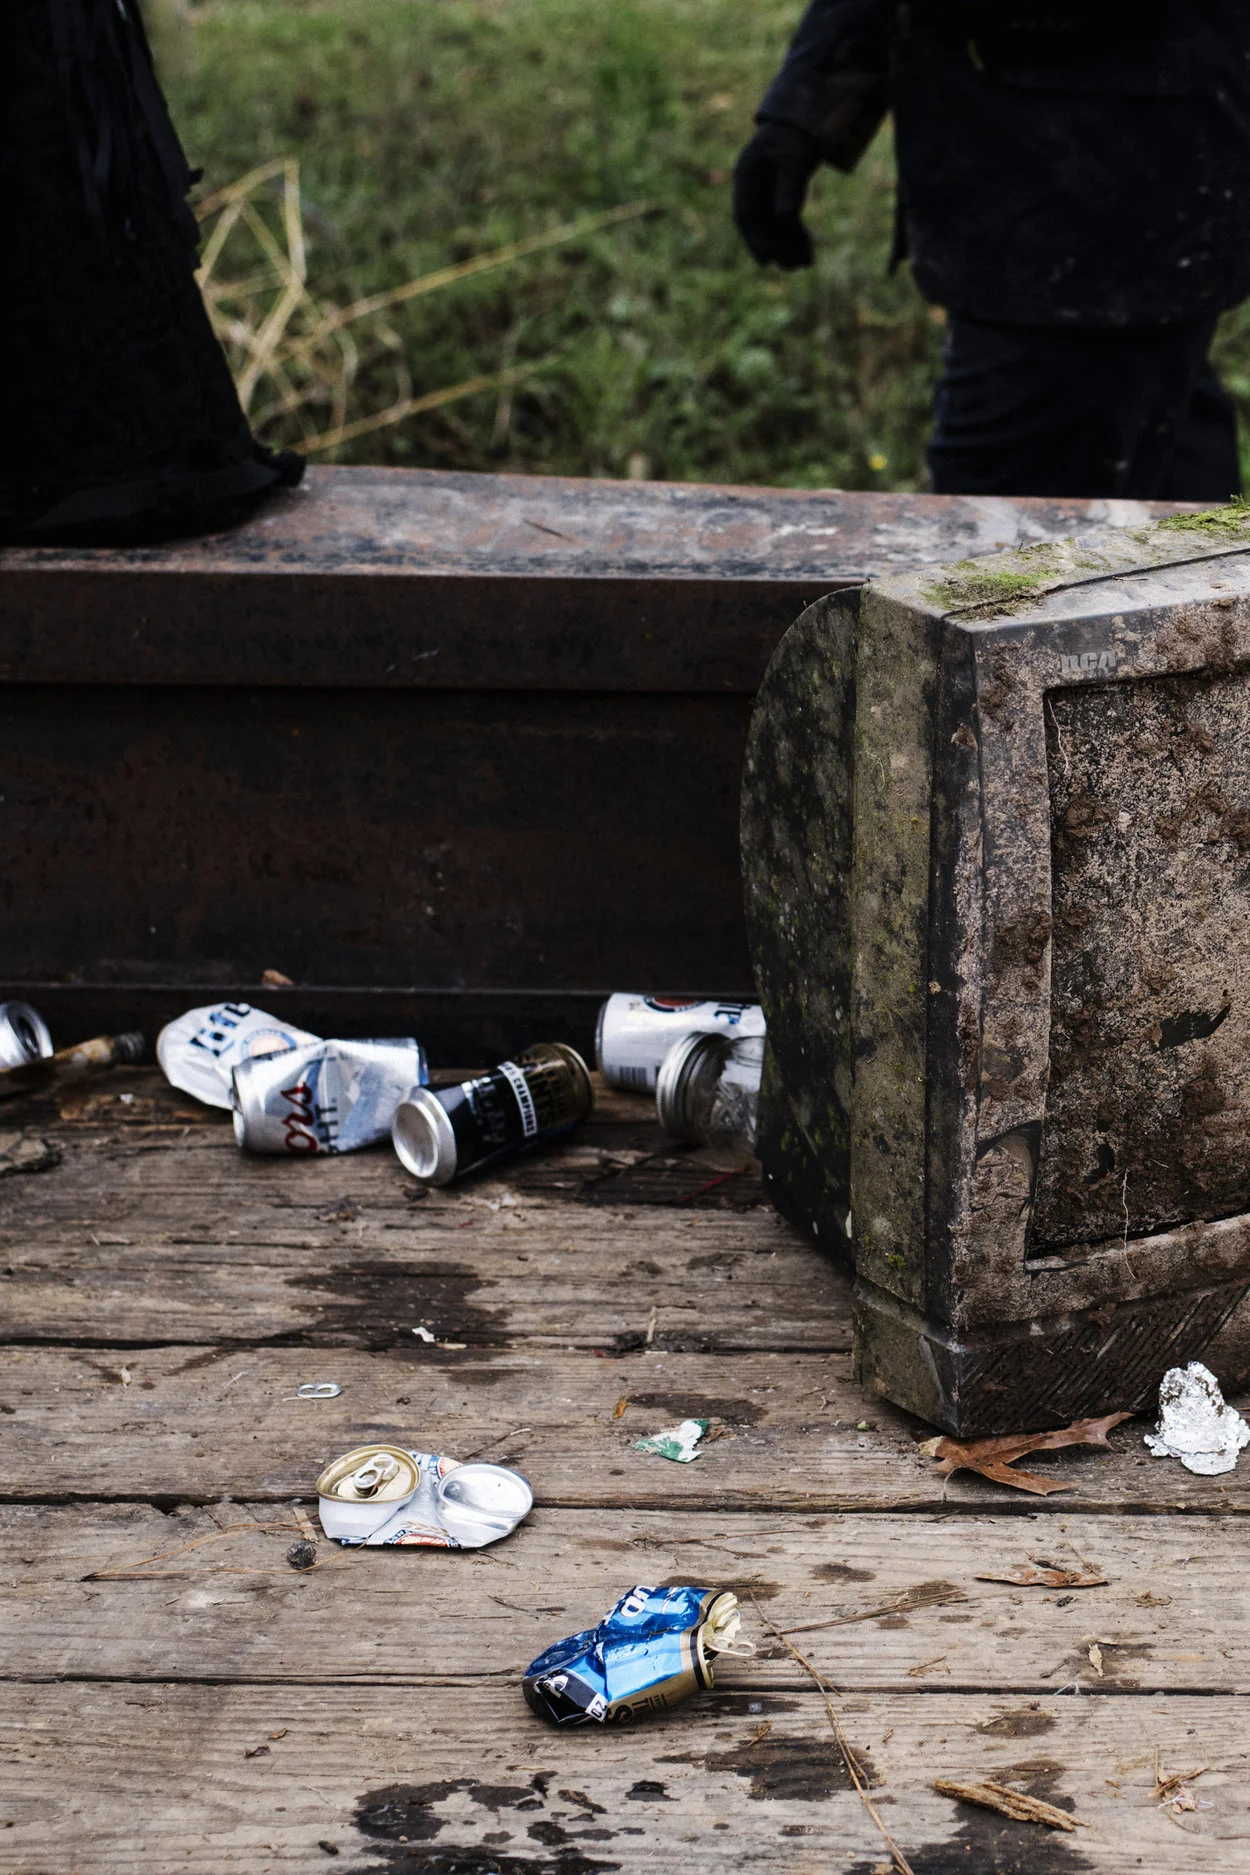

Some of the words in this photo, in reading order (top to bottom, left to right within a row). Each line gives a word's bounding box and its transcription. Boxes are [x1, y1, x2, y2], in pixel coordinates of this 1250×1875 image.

[1061, 651, 1117, 674] RCA
[280, 1081, 319, 1151] ors
[620, 1585, 656, 1617] UD
